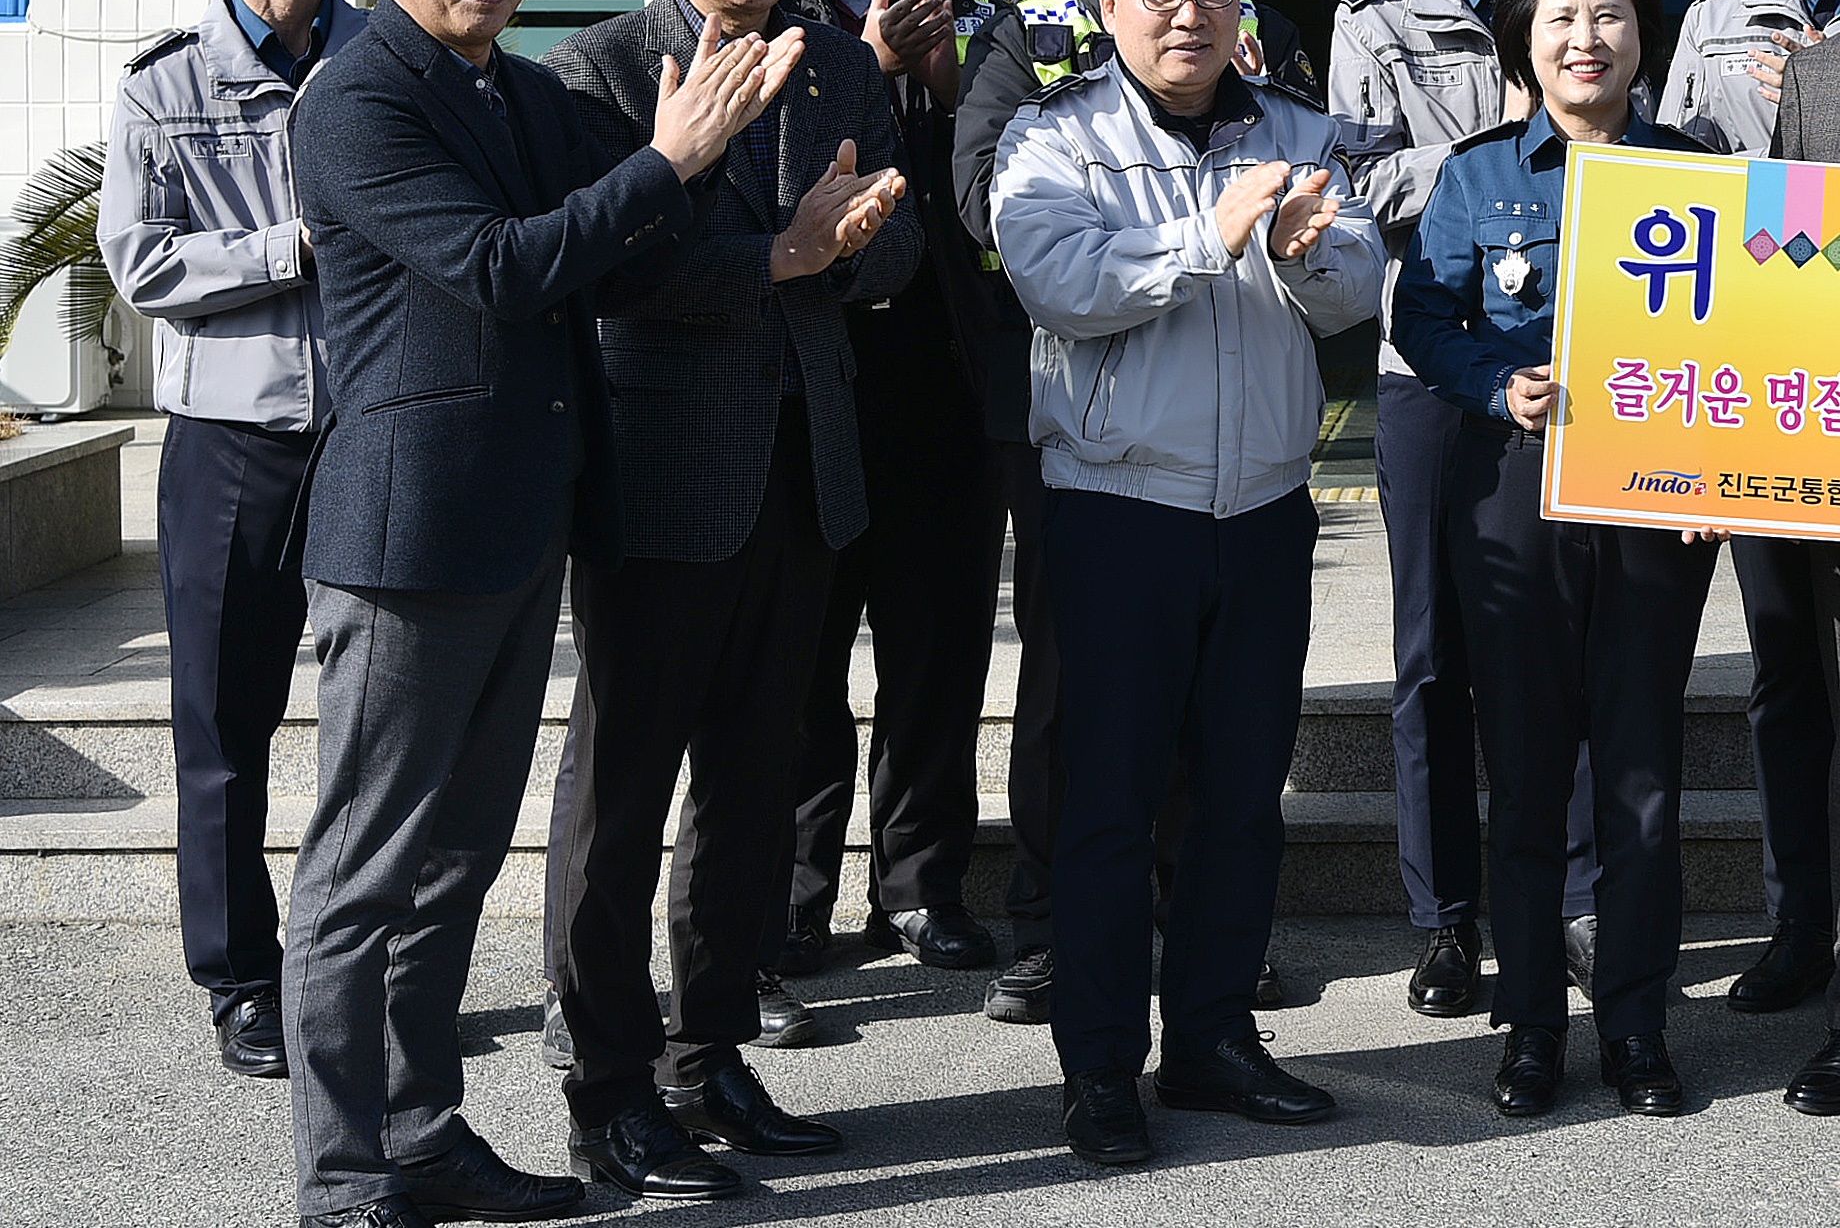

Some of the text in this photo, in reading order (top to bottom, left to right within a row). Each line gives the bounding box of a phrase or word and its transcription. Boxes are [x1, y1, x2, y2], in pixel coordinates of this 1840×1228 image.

[1619, 206, 1717, 320] 위
[1608, 362, 1749, 425] 즐거운
[1622, 470, 1692, 495] Jindo
